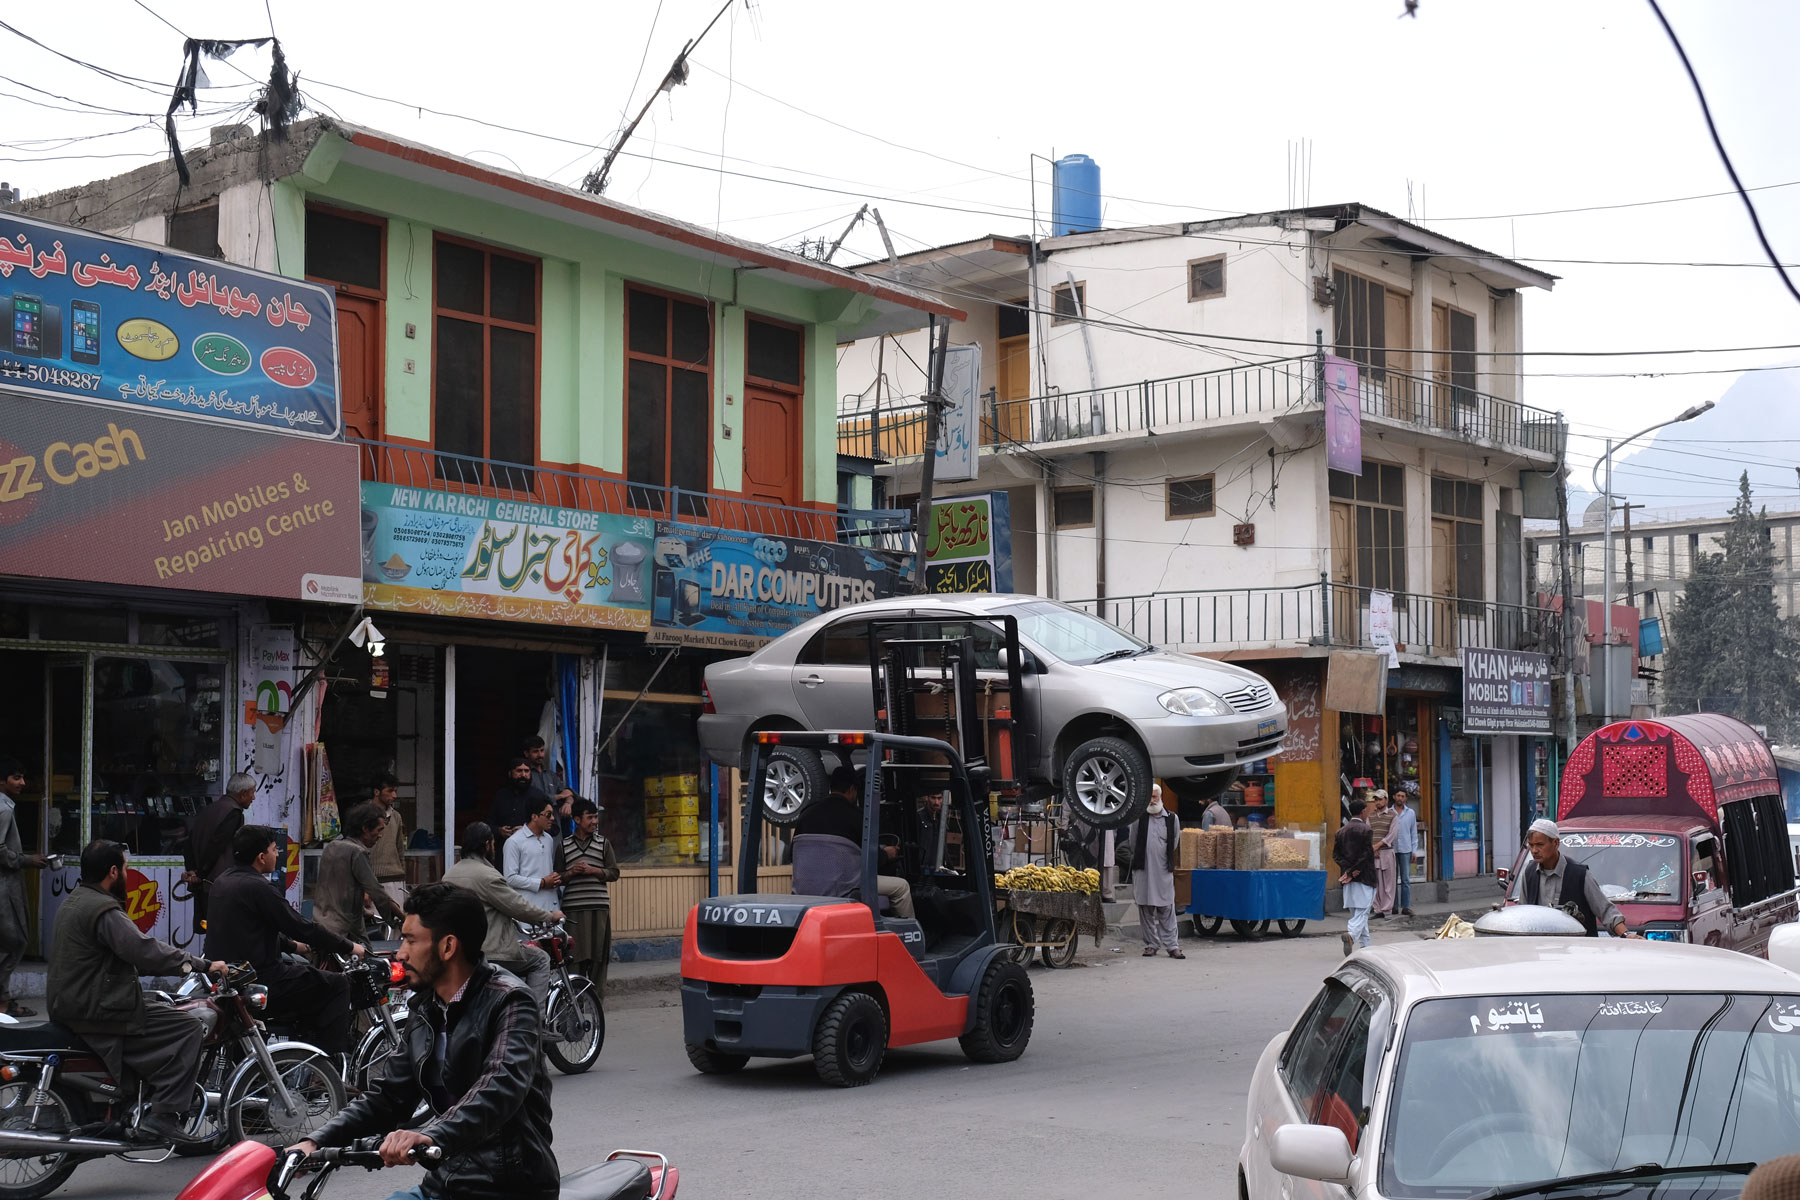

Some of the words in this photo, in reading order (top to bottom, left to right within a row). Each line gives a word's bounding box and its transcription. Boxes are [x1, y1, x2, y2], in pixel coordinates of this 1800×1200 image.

[73, 253, 141, 290] منی
[145, 261, 177, 300] اینڈ
[177, 270, 261, 318] موبائل
[266, 293, 312, 332] جان
[117, 383, 137, 400] ہے
[43, 422, 147, 485] Cash
[162, 506, 200, 542] Jan
[201, 480, 290, 527] Mobiles
[293, 472, 311, 493] &
[390, 487, 422, 509] NEW
[423, 492, 491, 517] KARACHI
[495, 501, 555, 527] GENERAL
[557, 513, 600, 531] STORE
[154, 526, 264, 580] Repairing
[266, 499, 336, 536] Centre
[498, 523, 561, 592] جنرل
[689, 546, 713, 569] THE
[543, 529, 602, 605] کراچی
[584, 547, 611, 589] نیو
[710, 562, 754, 600] DAR
[756, 567, 876, 608] COMPUTERS
[710, 599, 724, 610] Deal
[765, 605, 792, 617] Computer
[262, 650, 290, 663] PayMax
[653, 632, 661, 641] Al
[661, 633, 682, 643] Farooq
[683, 635, 705, 644] Market
[706, 637, 717, 645] NLI
[718, 638, 738, 647] Chowk
[738, 640, 755, 650] Gilgit
[1469, 652, 1508, 681] KHAN
[1509, 656, 1534, 678] موبائل
[1535, 659, 1547, 679] خان
[1469, 683, 1508, 702] MOBILES
[983, 807, 993, 860] TOYOTA
[703, 904, 782, 925] TOYOTA
[903, 931, 922, 943] 30
